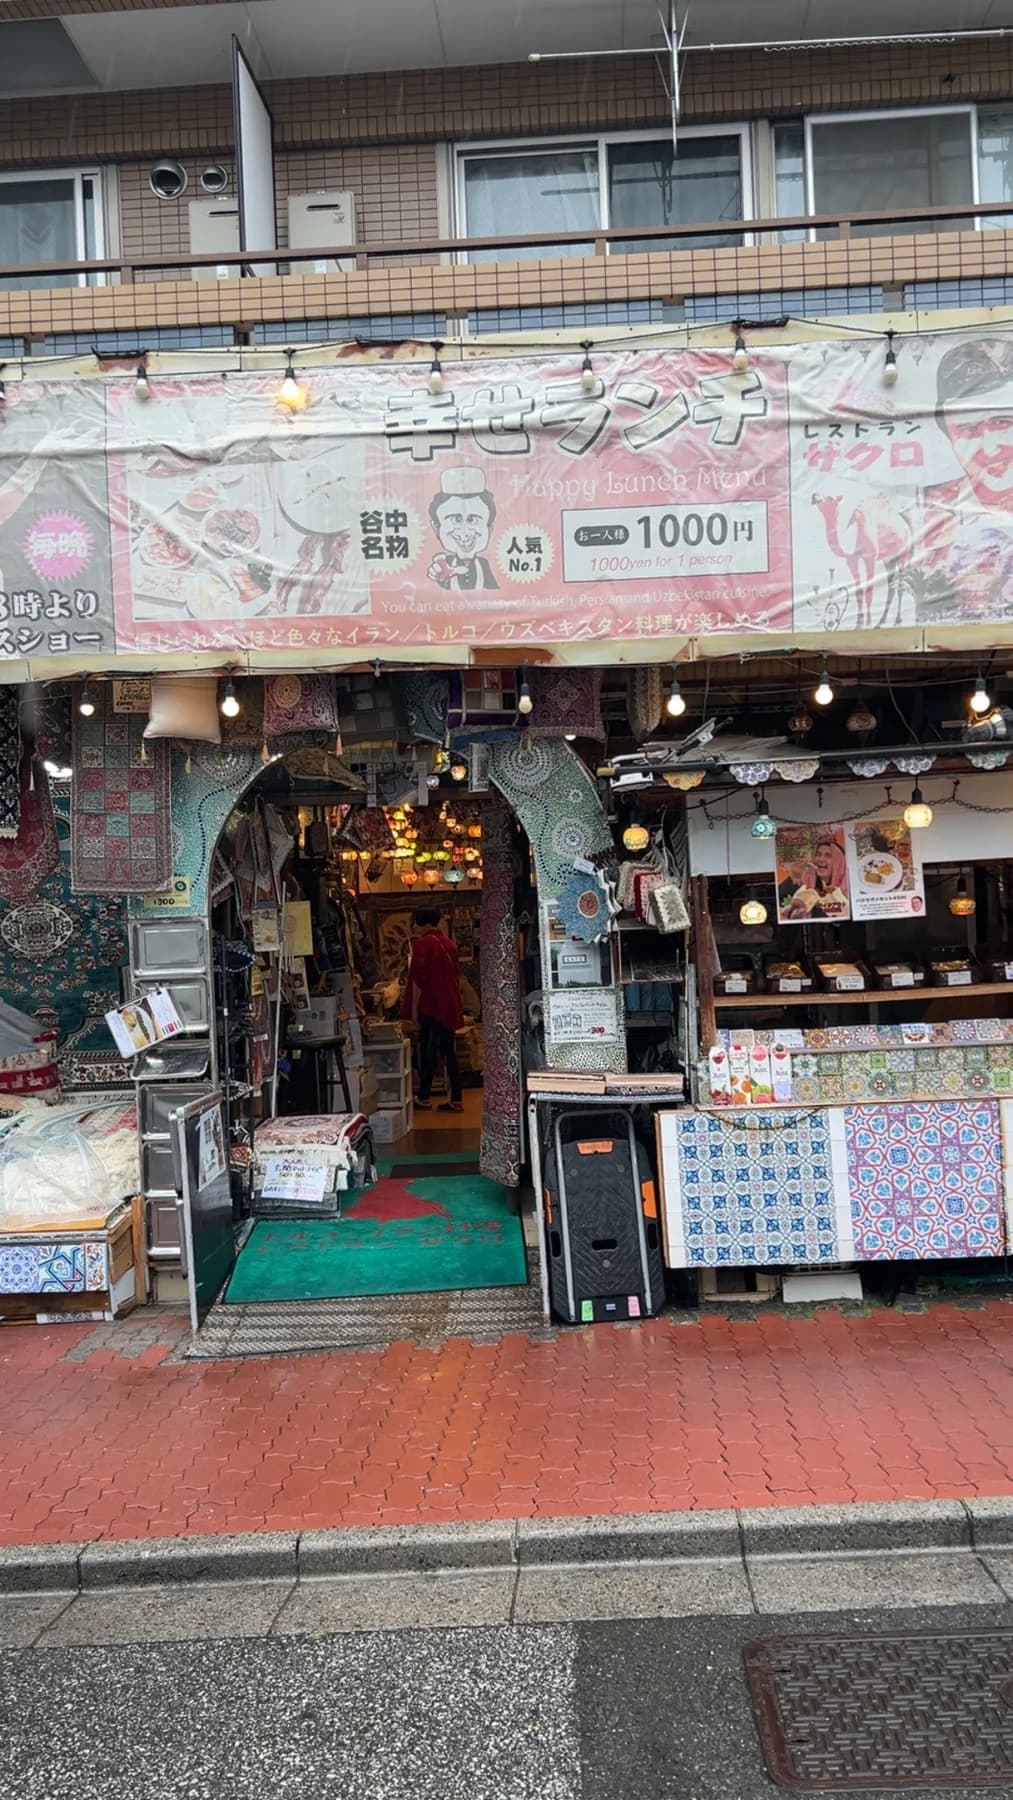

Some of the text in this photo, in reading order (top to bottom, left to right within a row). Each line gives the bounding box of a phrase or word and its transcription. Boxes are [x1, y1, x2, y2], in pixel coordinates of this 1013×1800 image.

[383, 370, 768, 461] 幸せランチ
[804, 420, 922, 440] レストラン
[803, 440, 925, 473] ザクロ
[511, 467, 767, 502] Happy Lunch Menu
[360, 509, 408, 534] 谷中
[577, 512, 754, 549] お一人様 1000円
[31, 530, 87, 559] 毎晩
[361, 535, 410, 560] 名物
[506, 536, 543, 554] 人気
[509, 557, 542, 572] No.1
[591, 556, 652, 572] 1000yen
[656, 556, 672, 567] for
[689, 553, 732, 568] person
[382, 601, 406, 613] You
[410, 602, 432, 613] can
[579, 594, 623, 606] Persian
[652, 588, 720, 602] Uzbekistan
